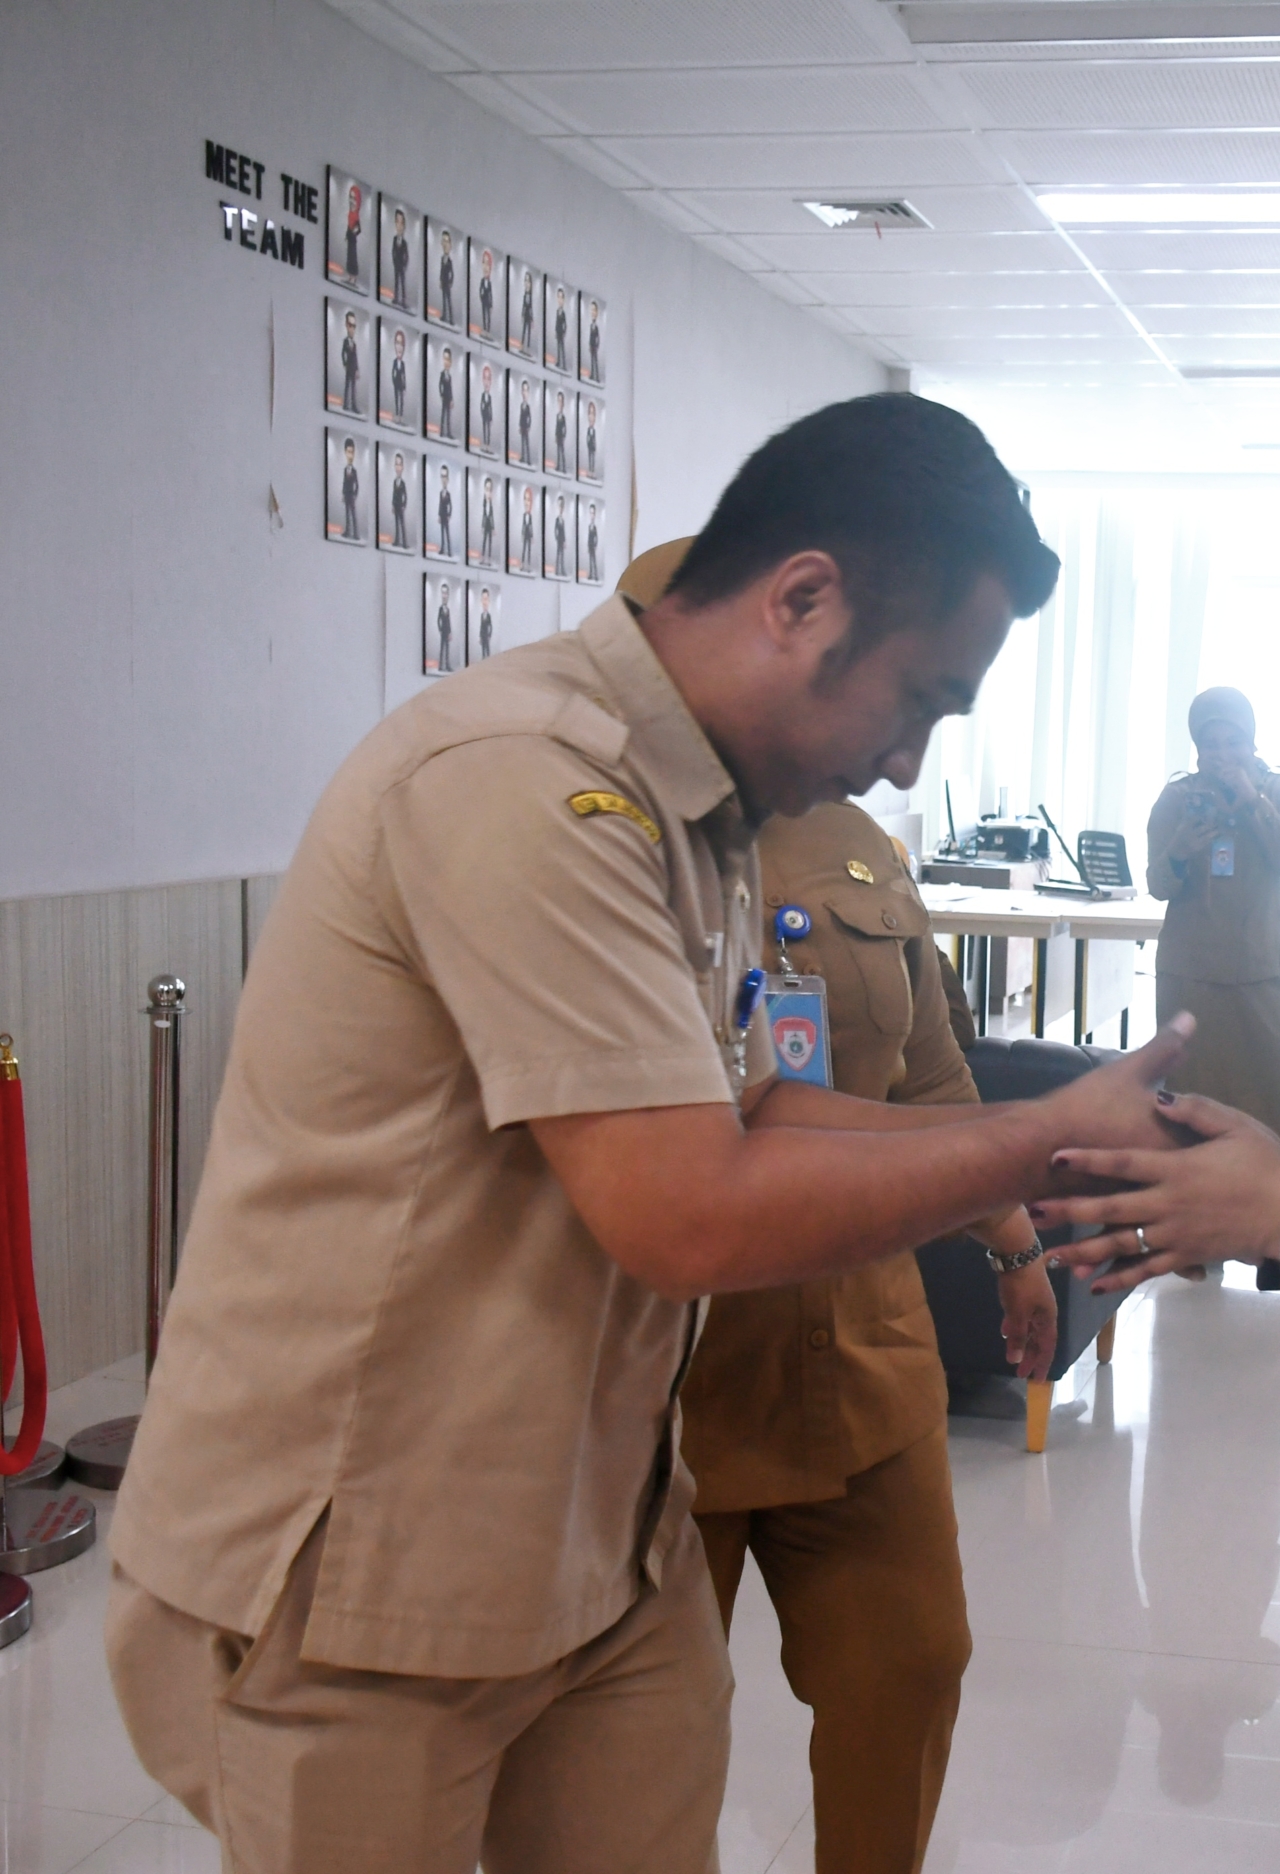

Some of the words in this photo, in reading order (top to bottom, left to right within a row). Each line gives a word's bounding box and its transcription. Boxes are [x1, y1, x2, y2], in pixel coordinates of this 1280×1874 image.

[205, 140, 265, 200] MEET
[281, 173, 319, 224] THE
[219, 200, 305, 270] TEAM
